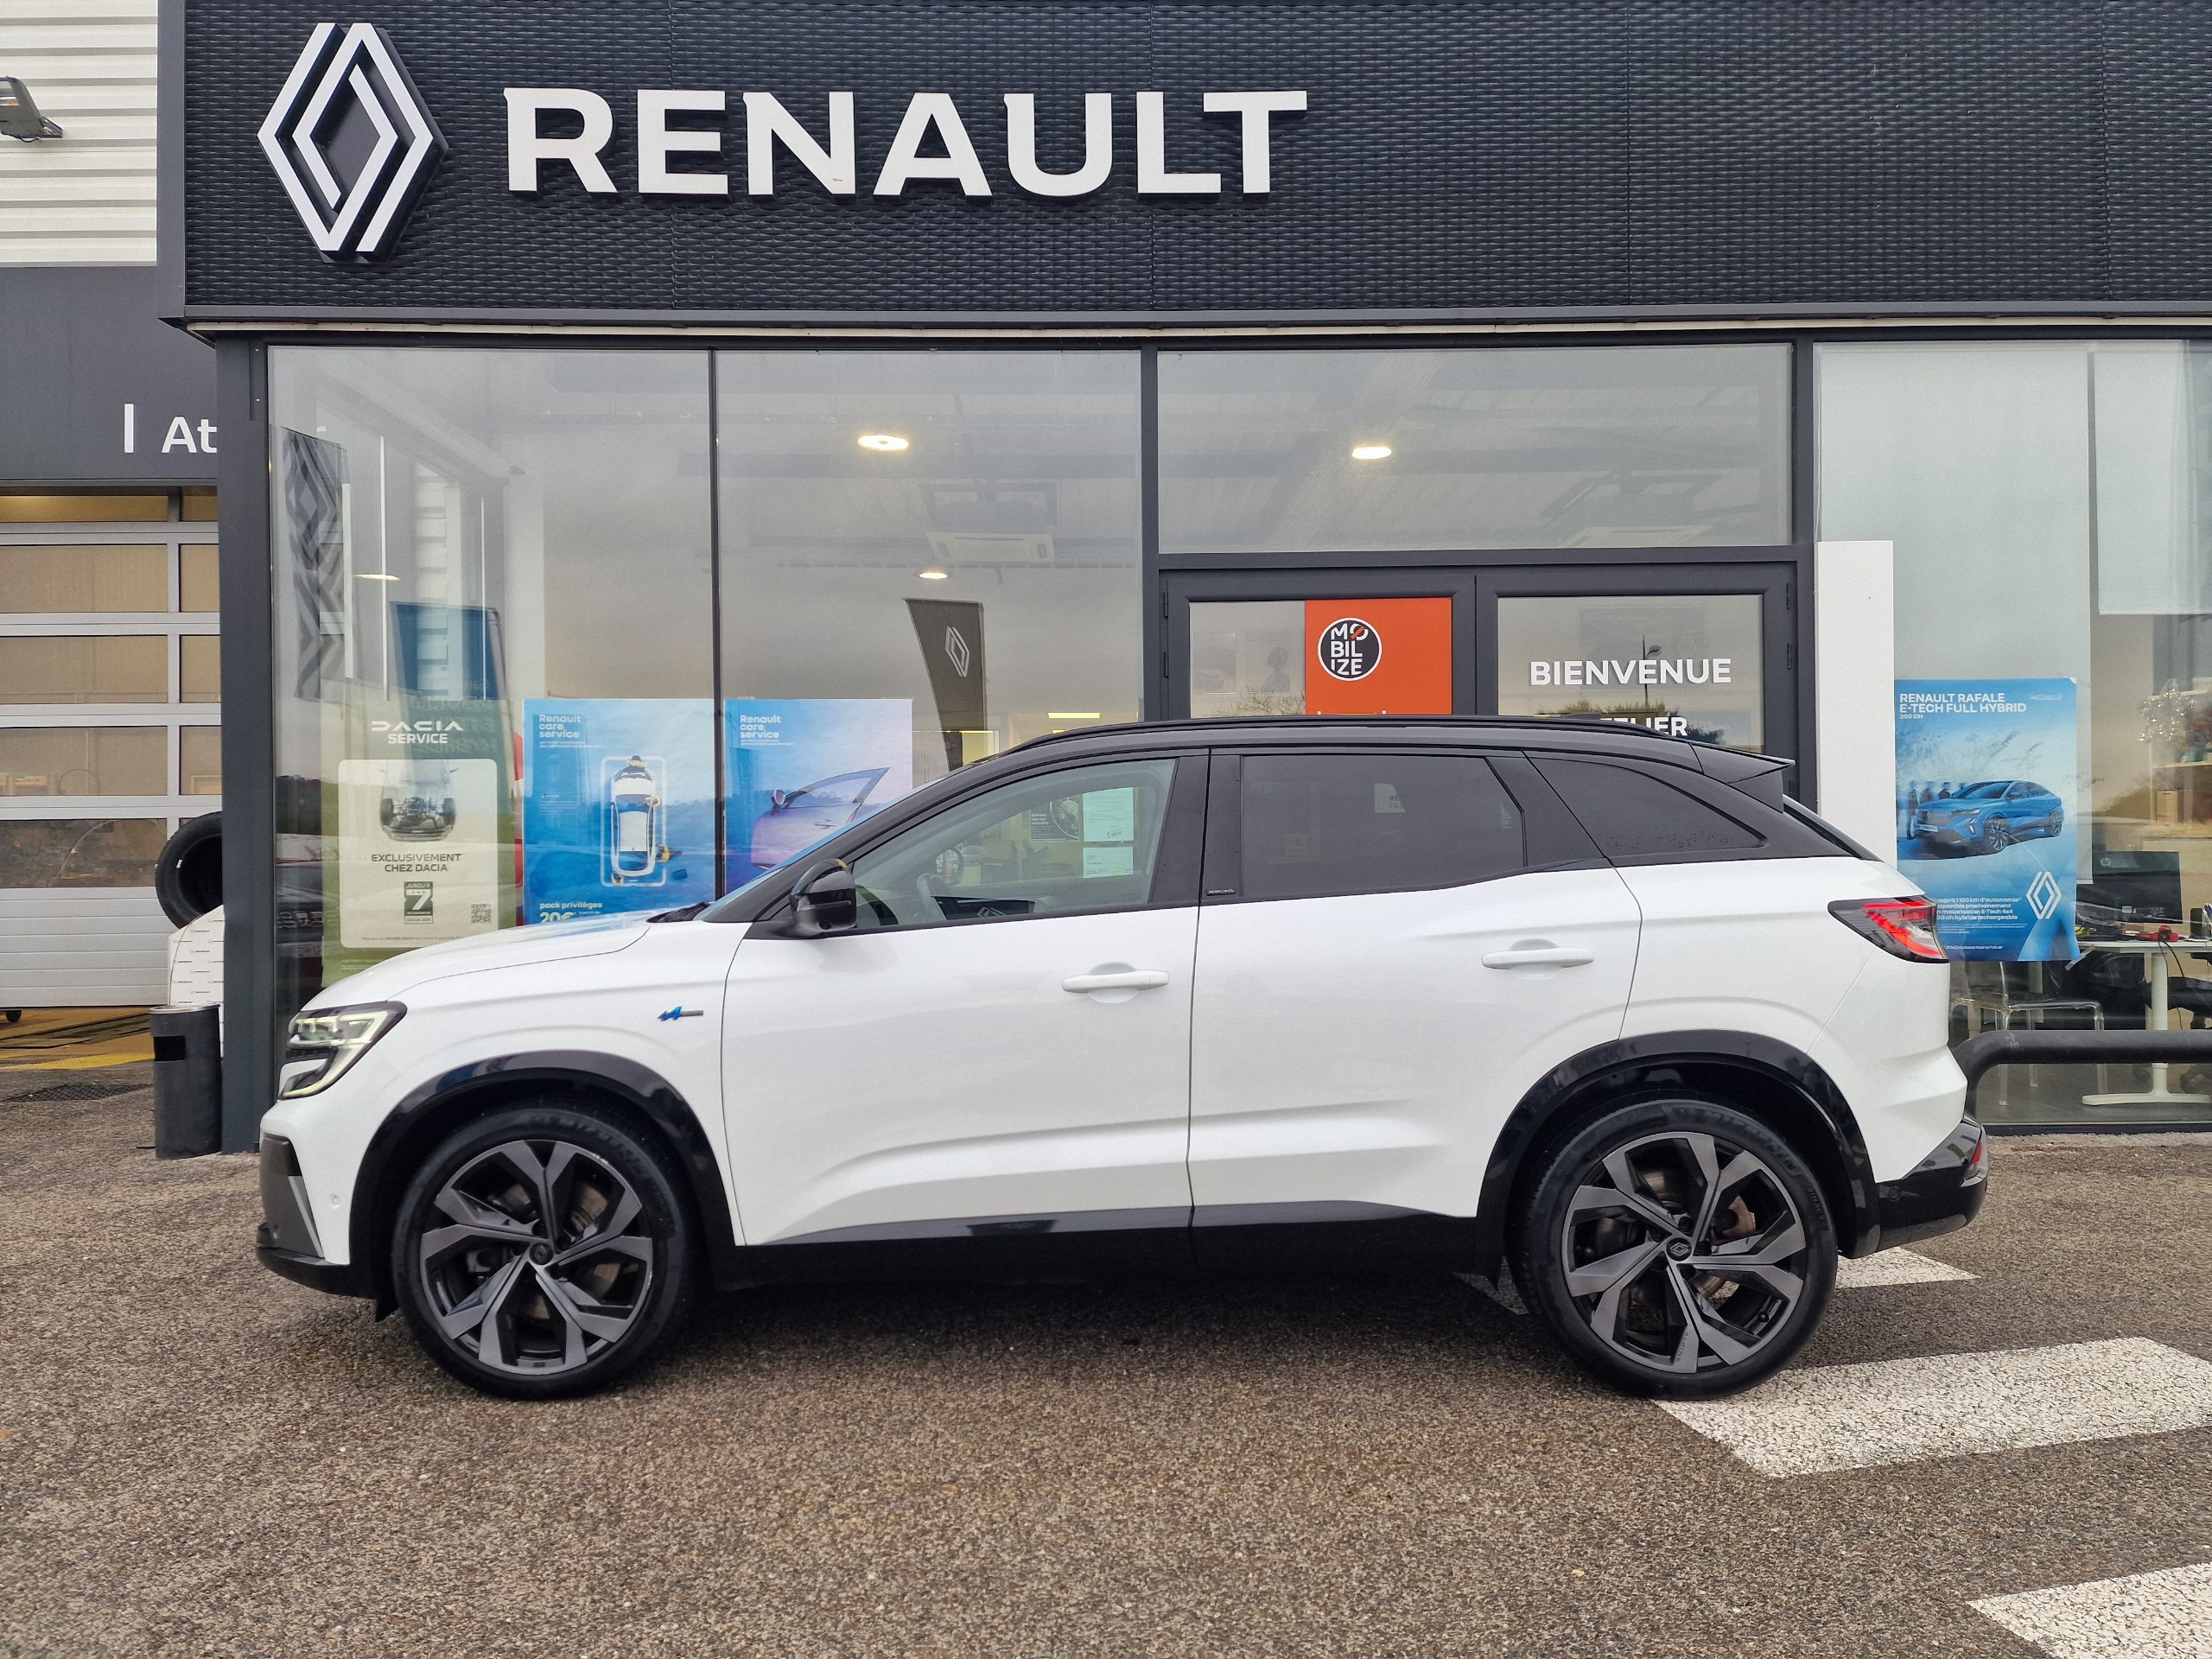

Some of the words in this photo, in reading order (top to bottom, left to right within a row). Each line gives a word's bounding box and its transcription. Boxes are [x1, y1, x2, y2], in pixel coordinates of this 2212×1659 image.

[504, 88, 1308, 196] RENAULT
[1529, 658, 1732, 686] BIENVENUE
[1899, 693, 1956, 703] RENAULT
[1957, 692, 2005, 702] RAFALE
[1899, 702, 1944, 714] E-TECH
[1946, 702, 1978, 713] FULL
[1980, 702, 2027, 713] HYBRID
[539, 714, 582, 722] Renault
[740, 714, 781, 723] Renault
[371, 720, 464, 732] DACIA
[387, 733, 448, 744] SERVICE
[539, 729, 580, 738] service
[740, 730, 779, 739] service
[371, 853, 462, 862] EXCLUSIVEMENT
[415, 863, 448, 872] DACIA
[539, 901, 561, 910] pack
[561, 900, 603, 910] privilèges
